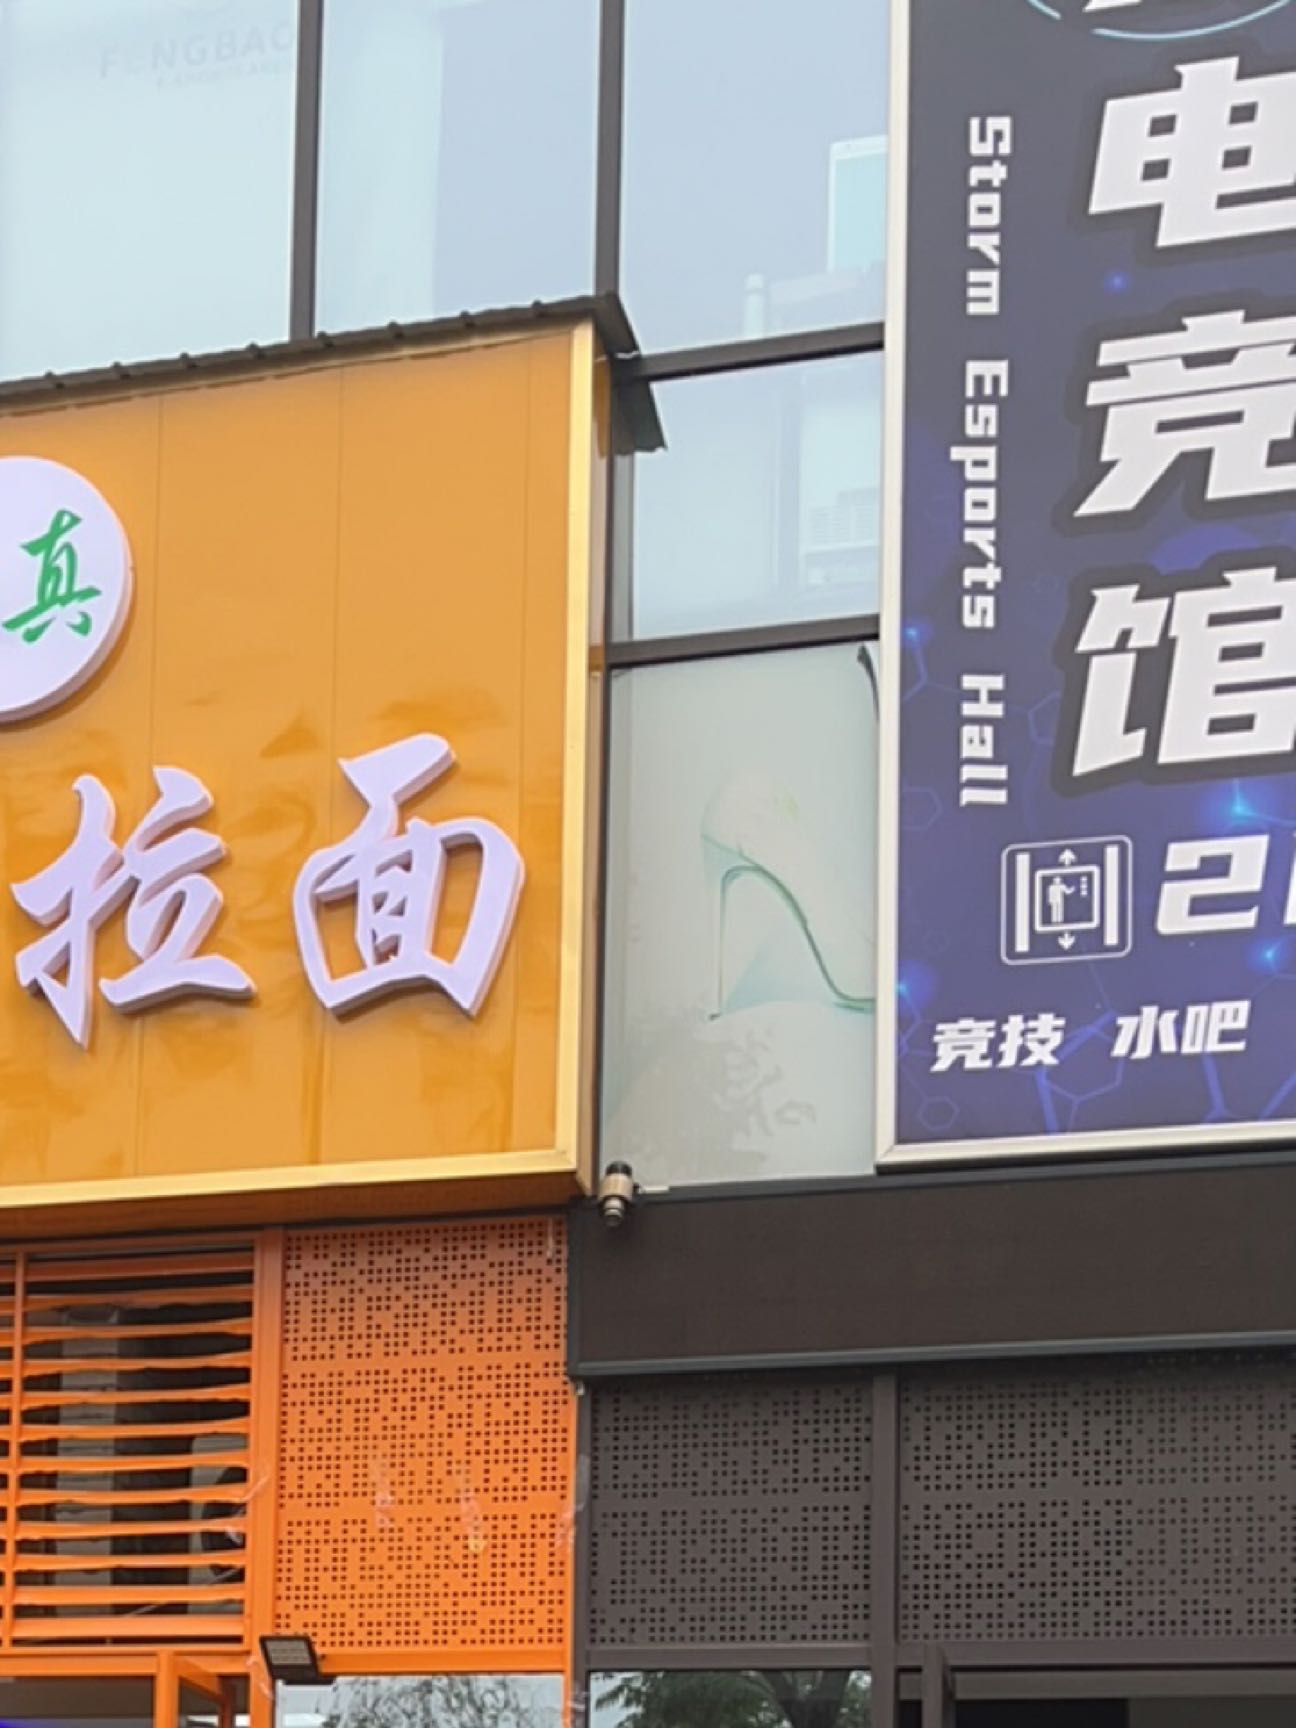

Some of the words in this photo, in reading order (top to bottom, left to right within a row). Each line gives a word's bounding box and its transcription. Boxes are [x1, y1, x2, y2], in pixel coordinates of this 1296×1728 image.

[966, 115, 1012, 315] Storm
[950, 359, 1009, 630] Esports
[1073, 57, 1296, 777] 电竞馆
[959, 673, 1008, 807] Hall
[929, 1012, 1066, 1072] 竞技
[1110, 999, 1251, 1060] 水吧
